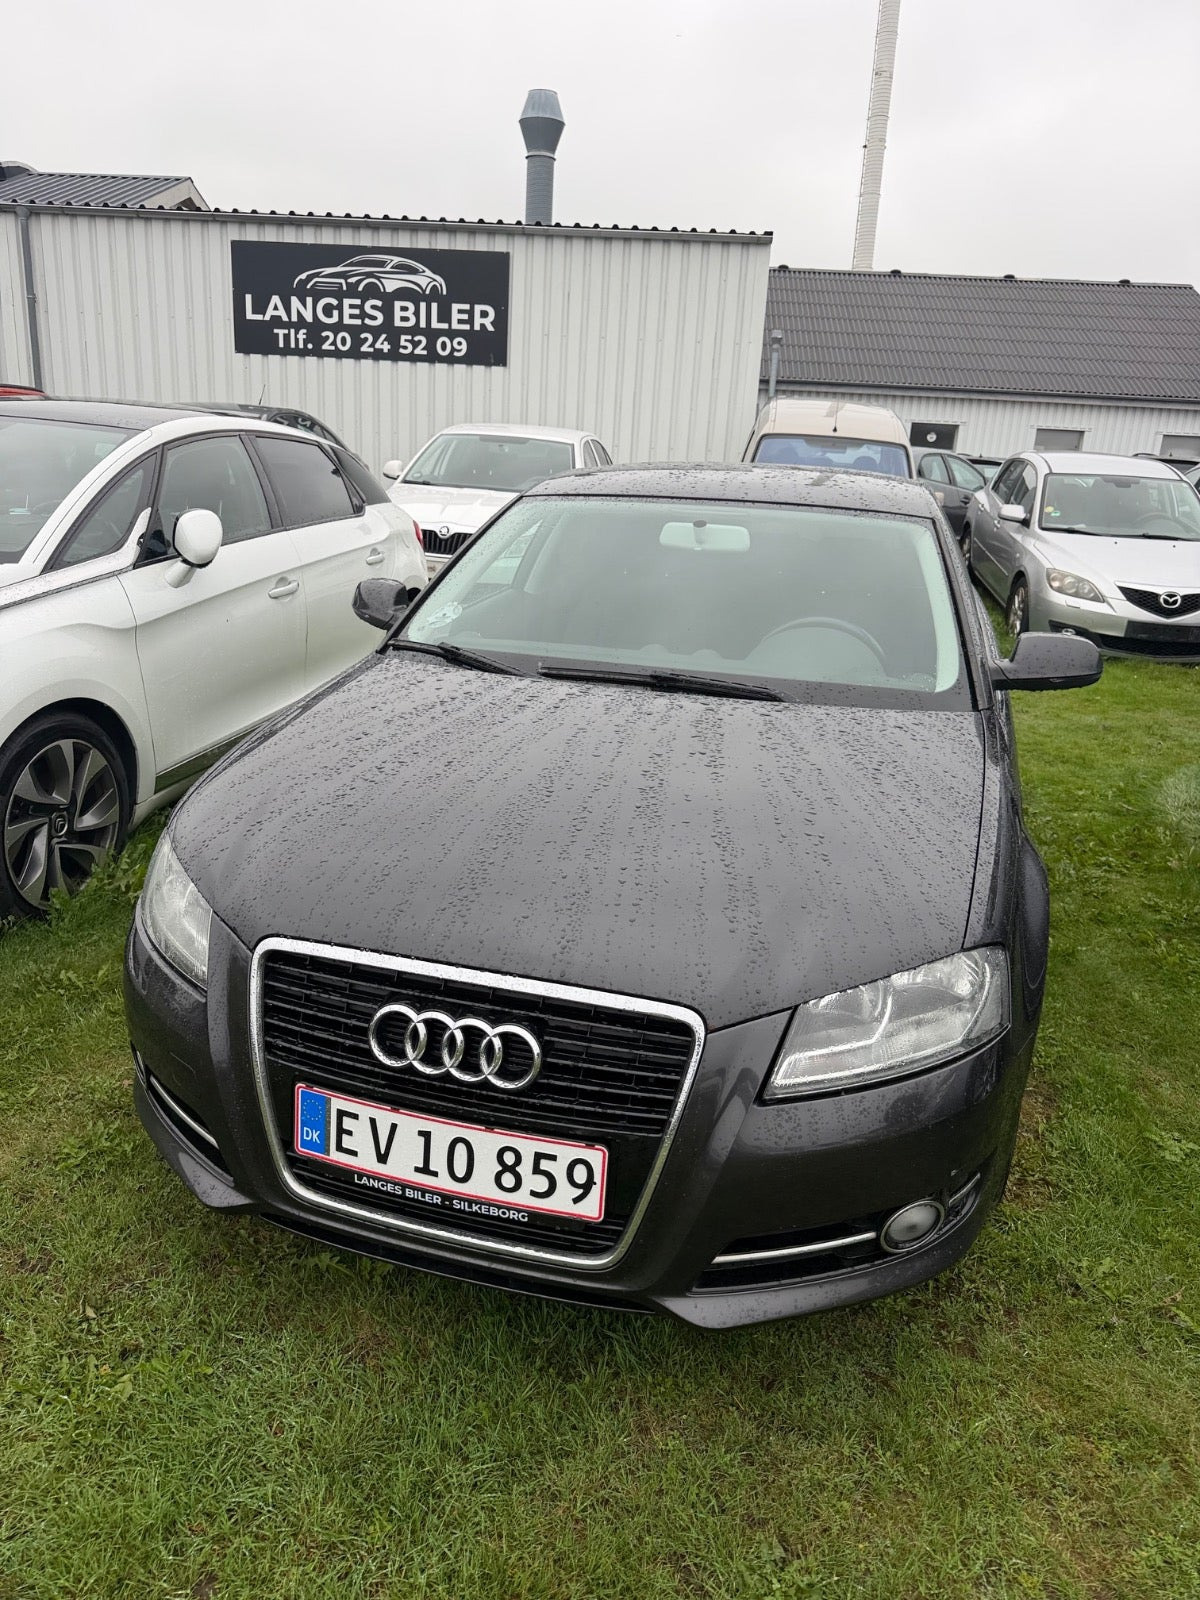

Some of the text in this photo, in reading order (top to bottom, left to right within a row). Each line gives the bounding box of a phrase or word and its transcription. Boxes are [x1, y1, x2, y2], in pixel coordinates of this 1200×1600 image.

[244, 294, 495, 331] LANGES BILER
[273, 328, 467, 357] Tlf. 20 24 52 09
[303, 1127, 321, 1144] DK
[335, 1108, 597, 1205] EV 10 859
[354, 1174, 402, 1195] LANGES
[405, 1188, 442, 1205] BILER
[453, 1199, 529, 1222] SILKEBORG
